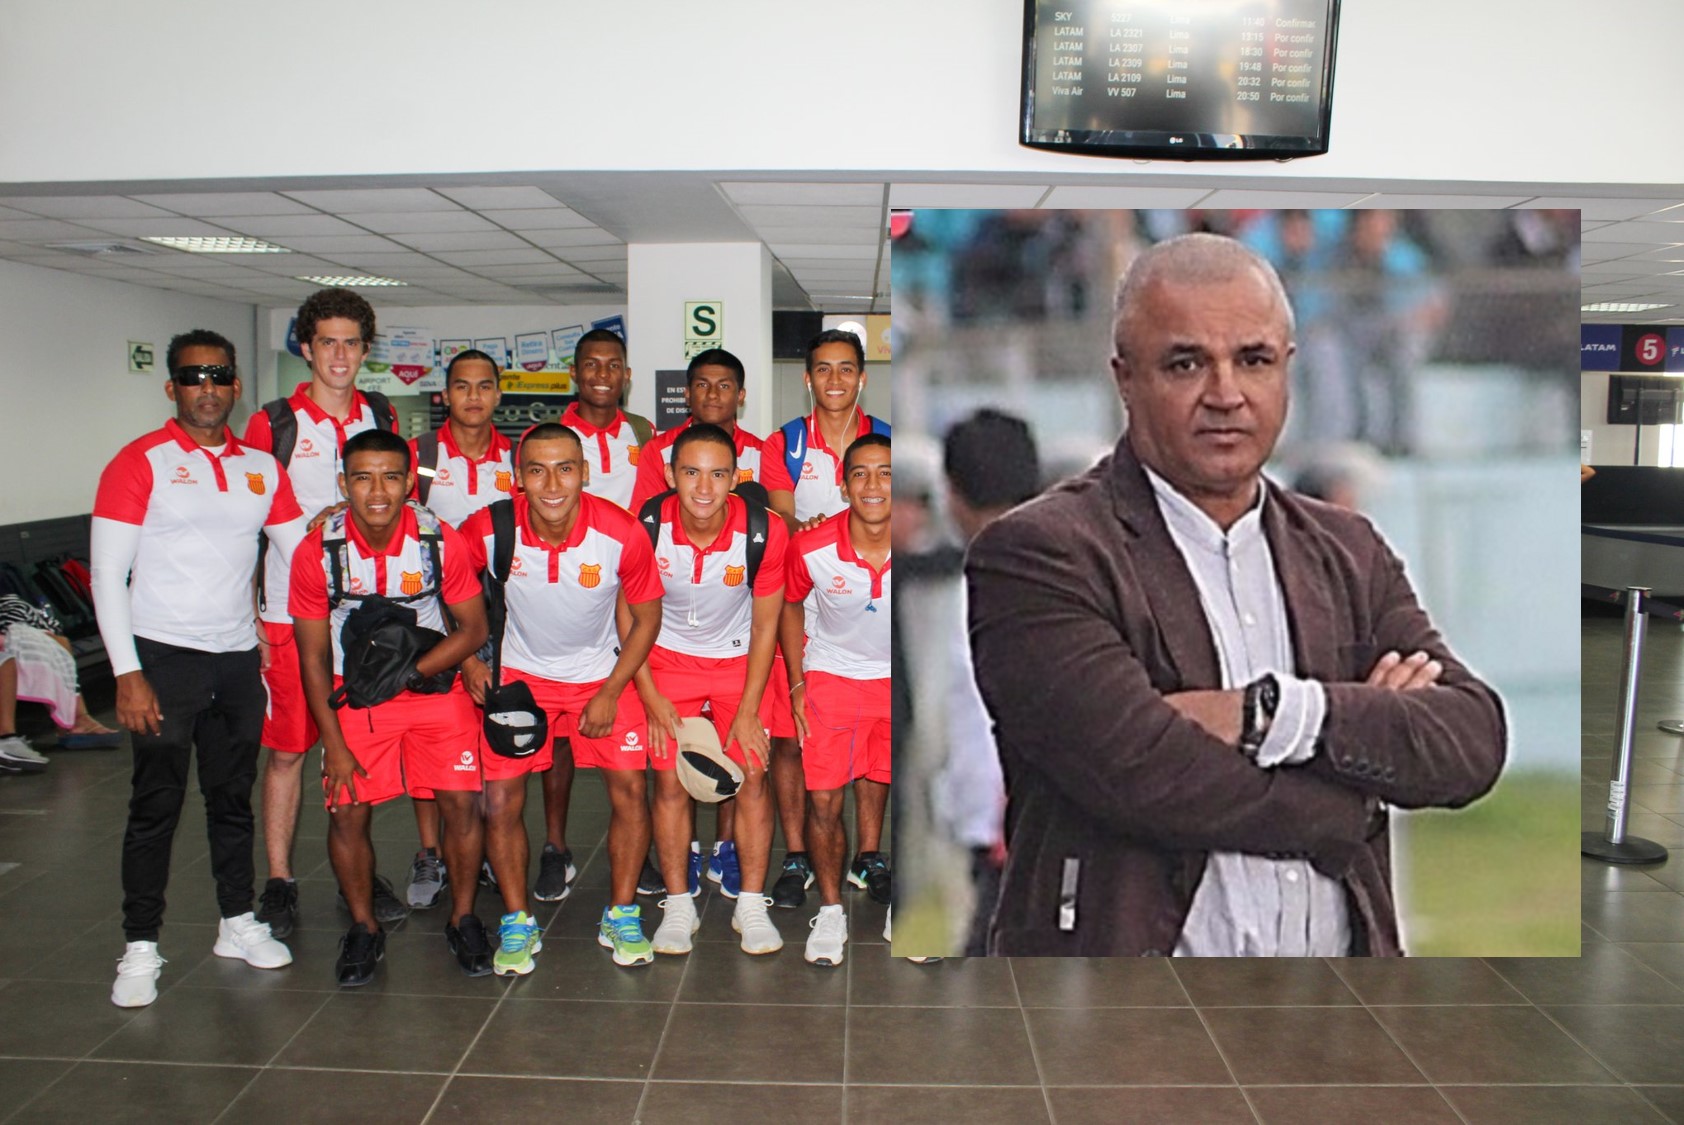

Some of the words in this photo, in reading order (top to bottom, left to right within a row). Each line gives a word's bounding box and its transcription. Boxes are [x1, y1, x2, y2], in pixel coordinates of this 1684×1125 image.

[1054, 11, 1072, 22] SKY
[1054, 26, 1084, 37] LATAM
[1110, 28, 1121, 38] LA
[1169, 30, 1190, 40] Lima
[1274, 33, 1288, 43] Por
[1054, 42, 1083, 52] LATAM
[1109, 43, 1120, 53] LA
[1168, 44, 1189, 54] Lima
[1274, 48, 1288, 58] Por
[1052, 56, 1082, 66] LATAM
[1108, 58, 1120, 68] LA
[1122, 58, 1142, 68] 2309
[1167, 60, 1188, 69] Lima
[1240, 62, 1262, 72] 19:48
[1272, 62, 1286, 72] Por
[1052, 72, 1082, 82] LATAM
[1108, 73, 1120, 82] LA
[1121, 73, 1142, 83] 2109
[1166, 74, 1187, 84] Lima
[1237, 76, 1260, 86] 20:32
[1270, 78, 1286, 87] Por
[1052, 86, 1070, 96] Viva
[1070, 86, 1084, 96] Air
[1107, 88, 1120, 97] VV
[1120, 88, 1136, 98] 507
[1166, 88, 1186, 98] Lima
[1236, 92, 1260, 101] 20:50
[1270, 92, 1284, 102] Por
[692, 305, 717, 336] S
[1642, 340, 1658, 360] 5
